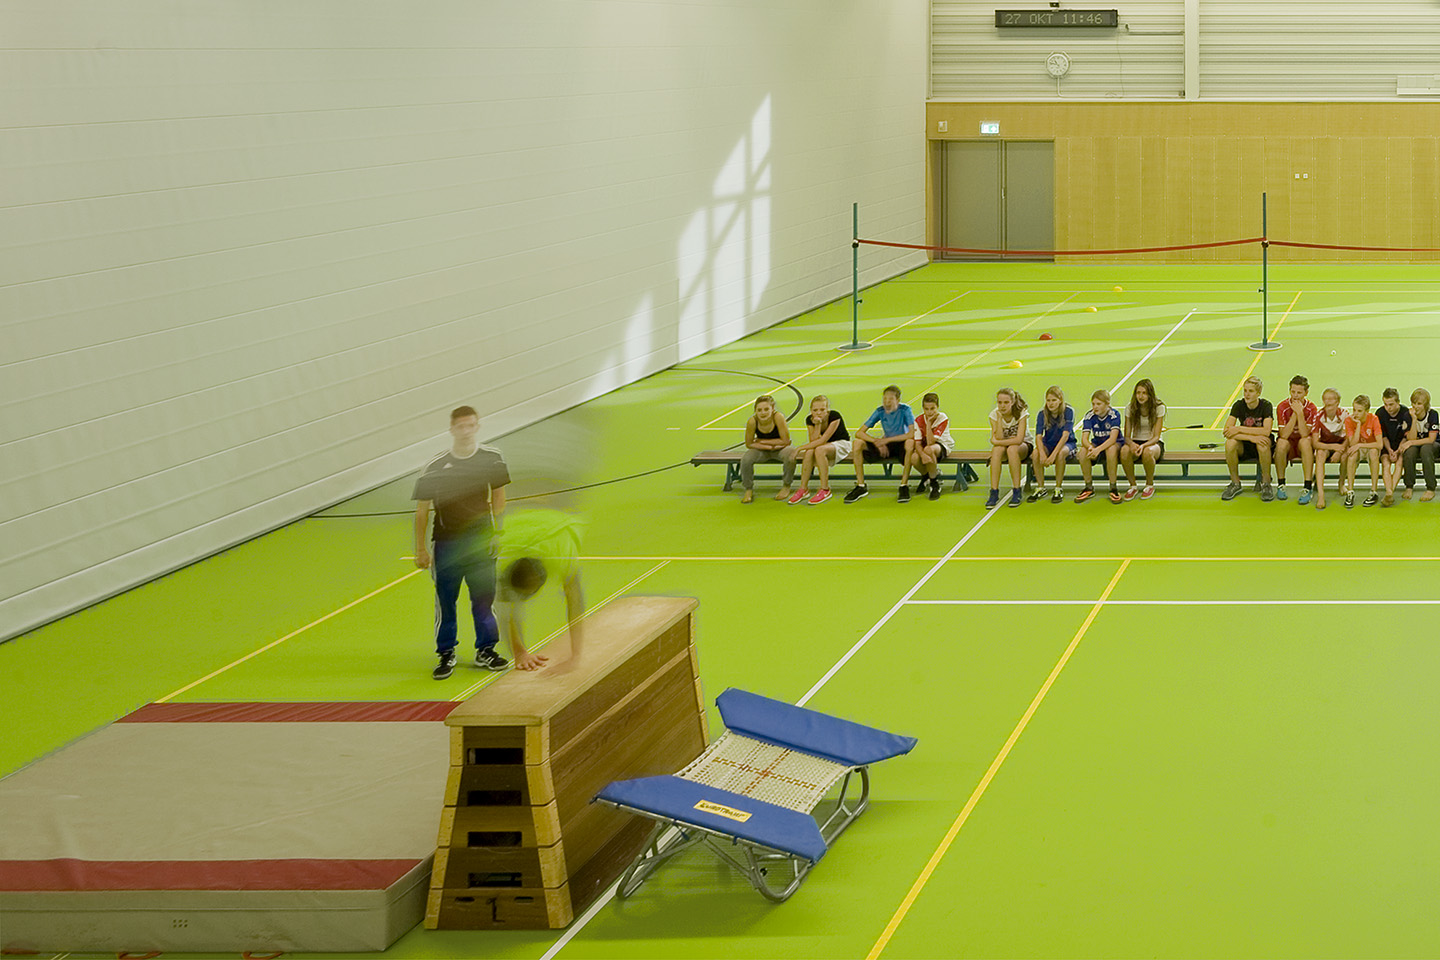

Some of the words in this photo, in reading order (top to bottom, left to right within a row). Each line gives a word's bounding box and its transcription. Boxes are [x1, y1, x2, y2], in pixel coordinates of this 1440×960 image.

[1005, 13, 1021, 24] 27
[1029, 13, 1054, 24] OKT
[1063, 13, 1103, 24] 11:46
